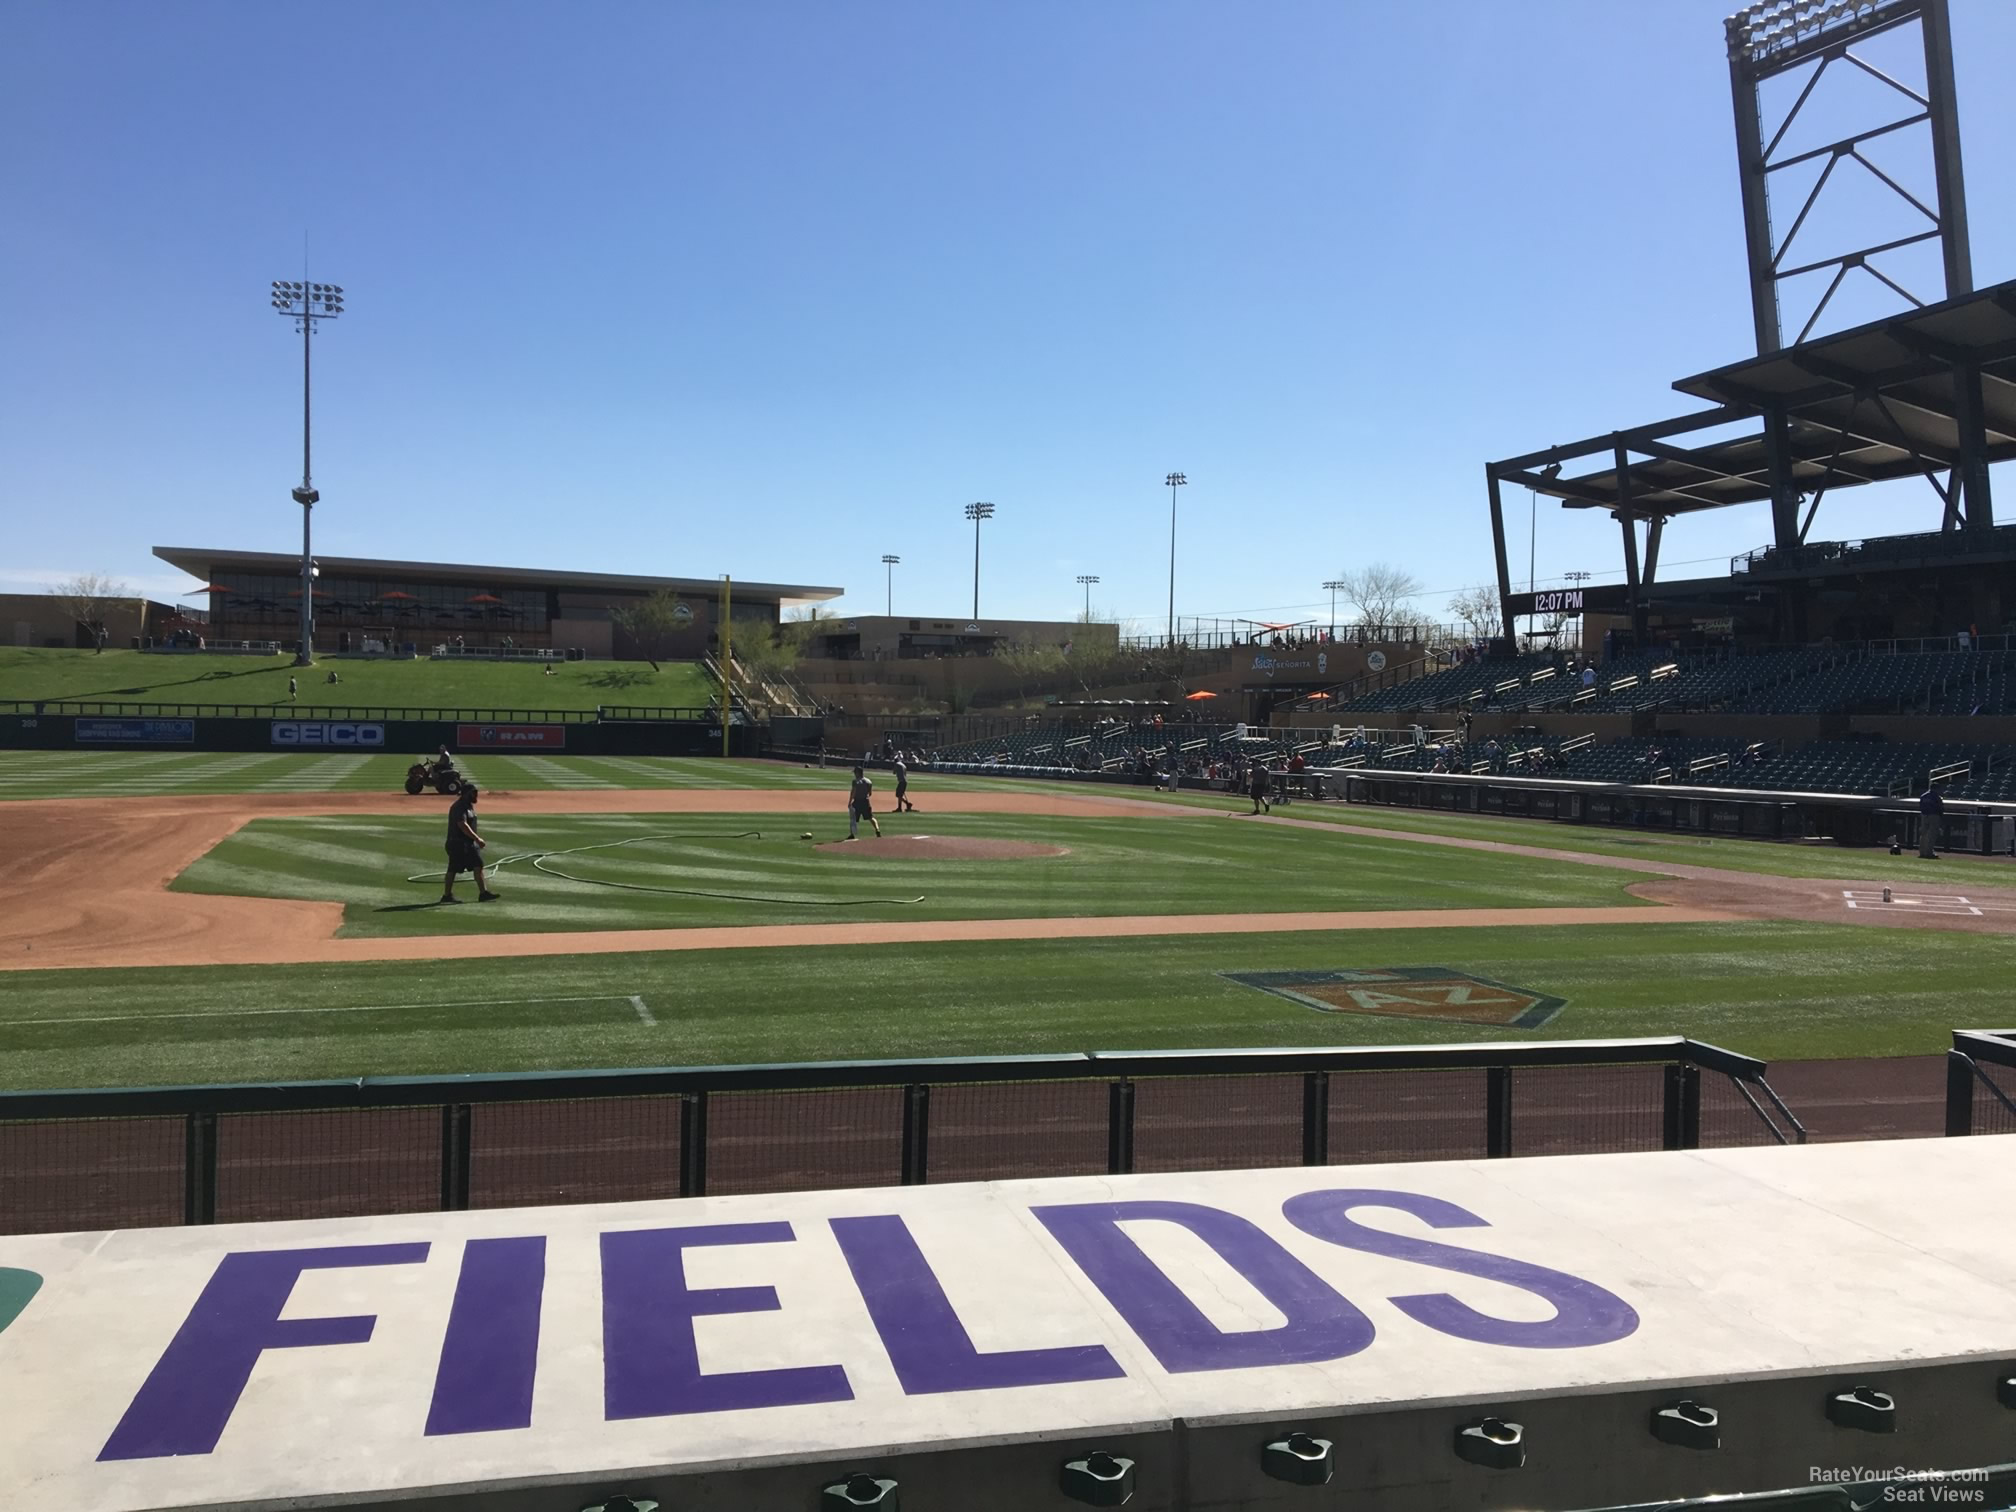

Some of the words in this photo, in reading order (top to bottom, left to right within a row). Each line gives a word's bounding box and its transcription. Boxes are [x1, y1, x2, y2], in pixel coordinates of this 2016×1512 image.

[1535, 592, 1563, 611] 12:07
[1565, 590, 1583, 609] PM
[272, 723, 384, 745] GEICO
[500, 731, 544, 741] RAM
[707, 728, 722, 736] 345
[98, 1187, 1640, 1461] FIELDS
